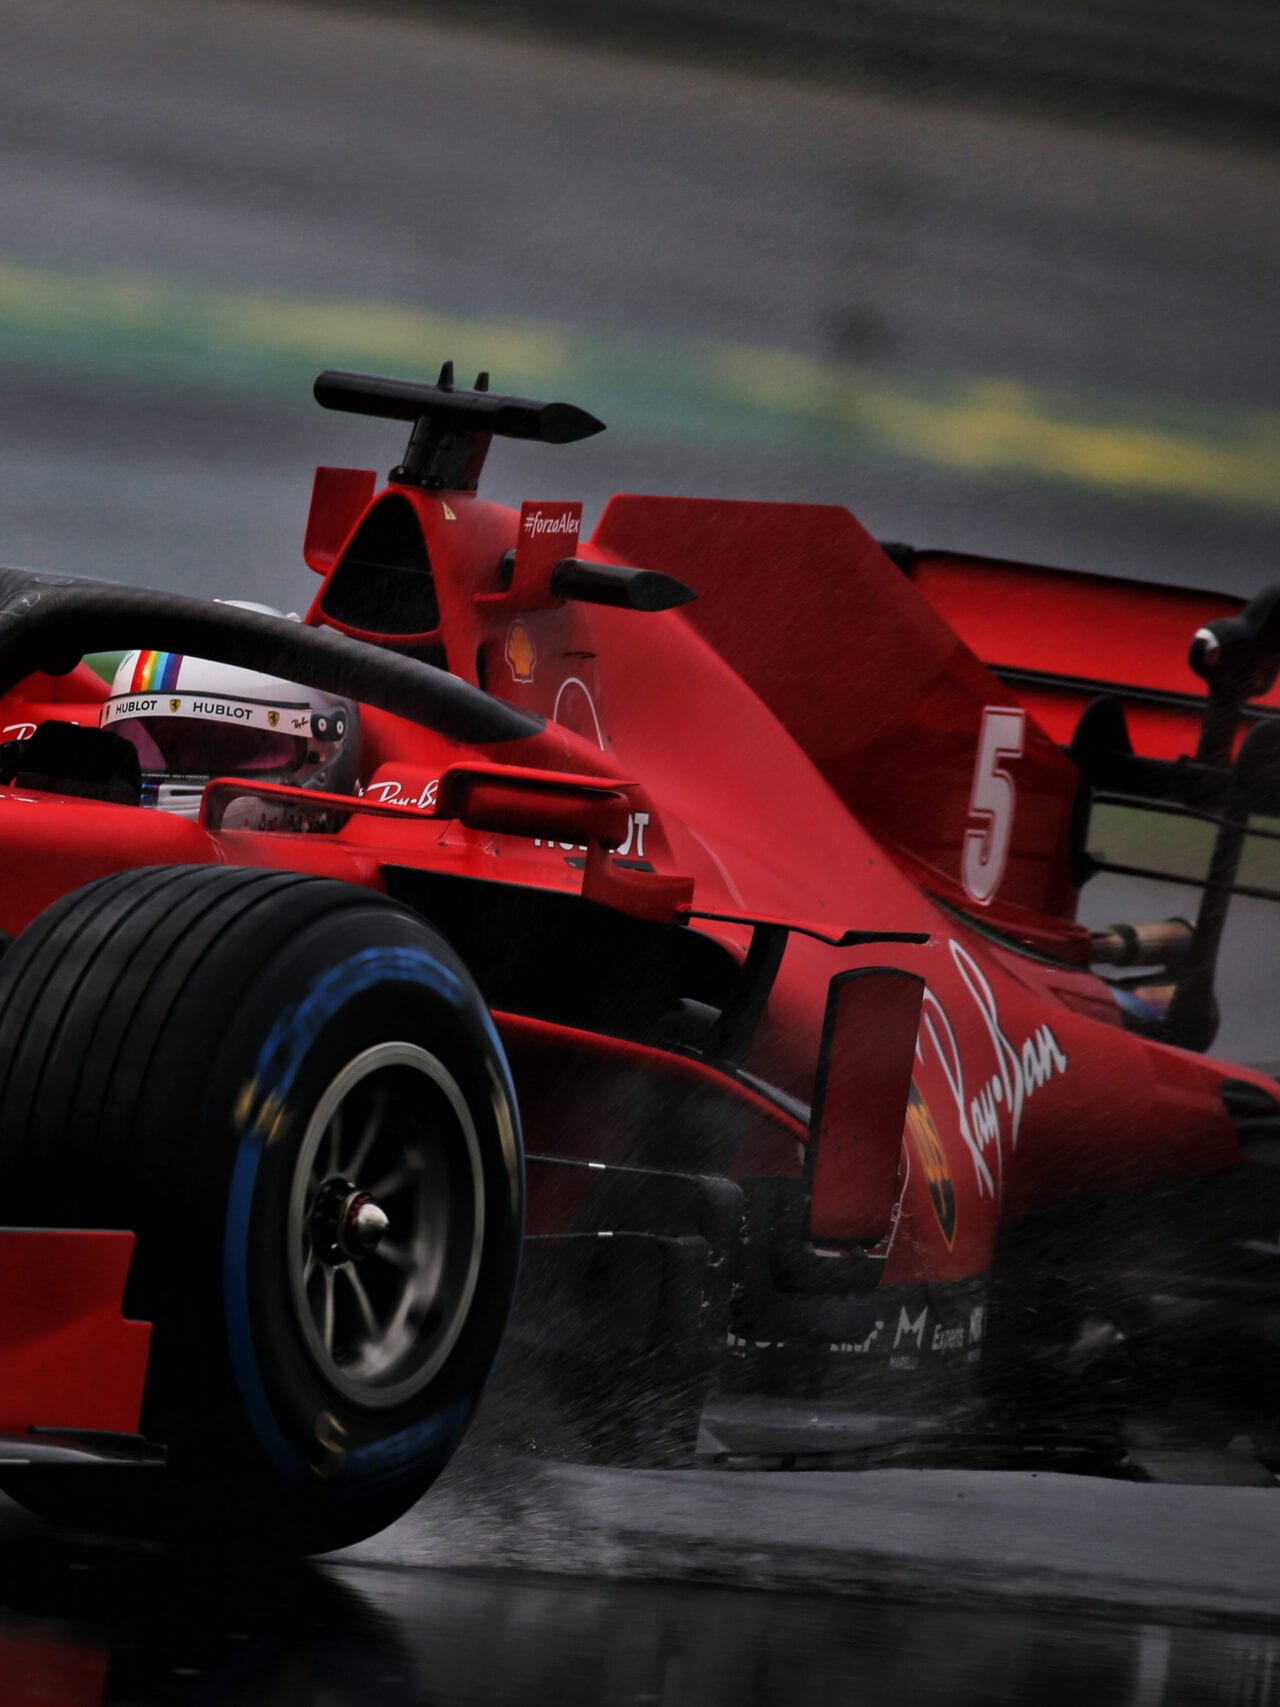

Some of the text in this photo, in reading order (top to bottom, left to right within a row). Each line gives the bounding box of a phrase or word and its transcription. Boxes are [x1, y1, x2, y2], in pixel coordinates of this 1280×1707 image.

[524, 511, 580, 538] #forzaAlex
[116, 700, 158, 715] HUBLOT
[193, 702, 253, 720] HUBLOT
[961, 705, 1025, 906] 5
